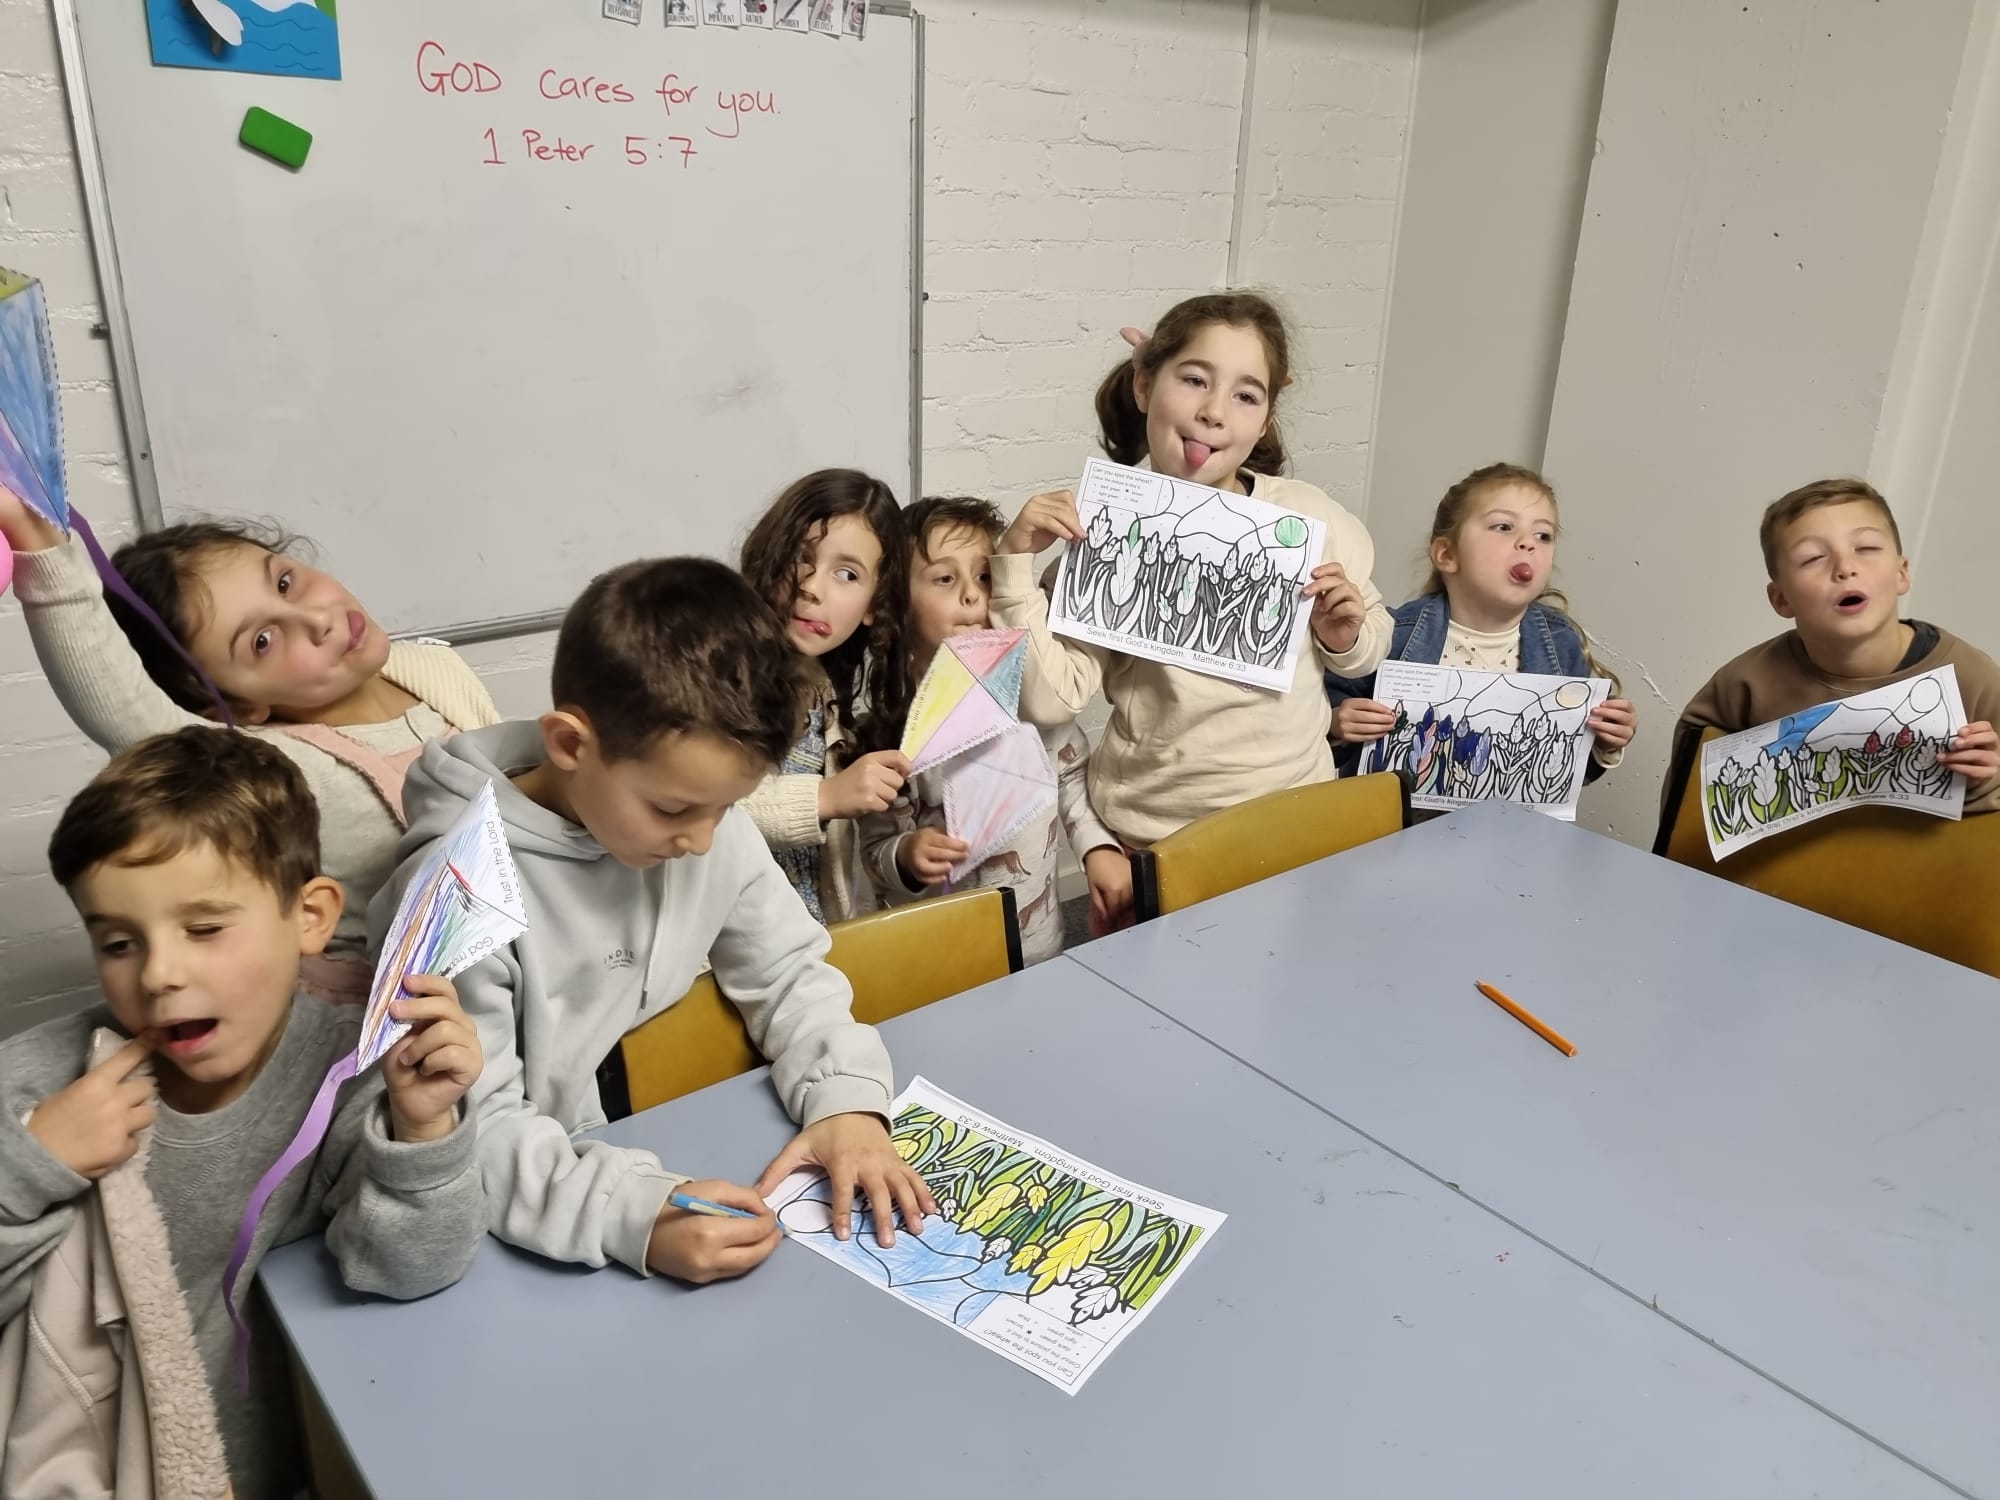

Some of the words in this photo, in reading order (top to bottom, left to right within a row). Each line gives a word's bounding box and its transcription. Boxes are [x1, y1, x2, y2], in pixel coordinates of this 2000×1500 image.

[416, 41, 502, 96] GOD
[656, 73, 698, 116] for
[705, 91, 781, 139] you.
[482, 127, 507, 165] 1
[521, 129, 595, 161] Peter
[625, 135, 698, 169] 5:7
[1086, 627, 1107, 640] Seek
[1109, 631, 1124, 643] first
[1125, 636, 1149, 650] God's
[1192, 653, 1227, 668] Matthew
[485, 820, 500, 845] Lord
[492, 847, 505, 866] the
[498, 867, 509, 878] in
[500, 880, 514, 904] Trust
[468, 936, 494, 956] God
[981, 1125, 1025, 1148] Matthew
[1080, 1169, 1112, 1189] God's
[1113, 1185, 1135, 1200] first
[1135, 1194, 1165, 1211] Seek
